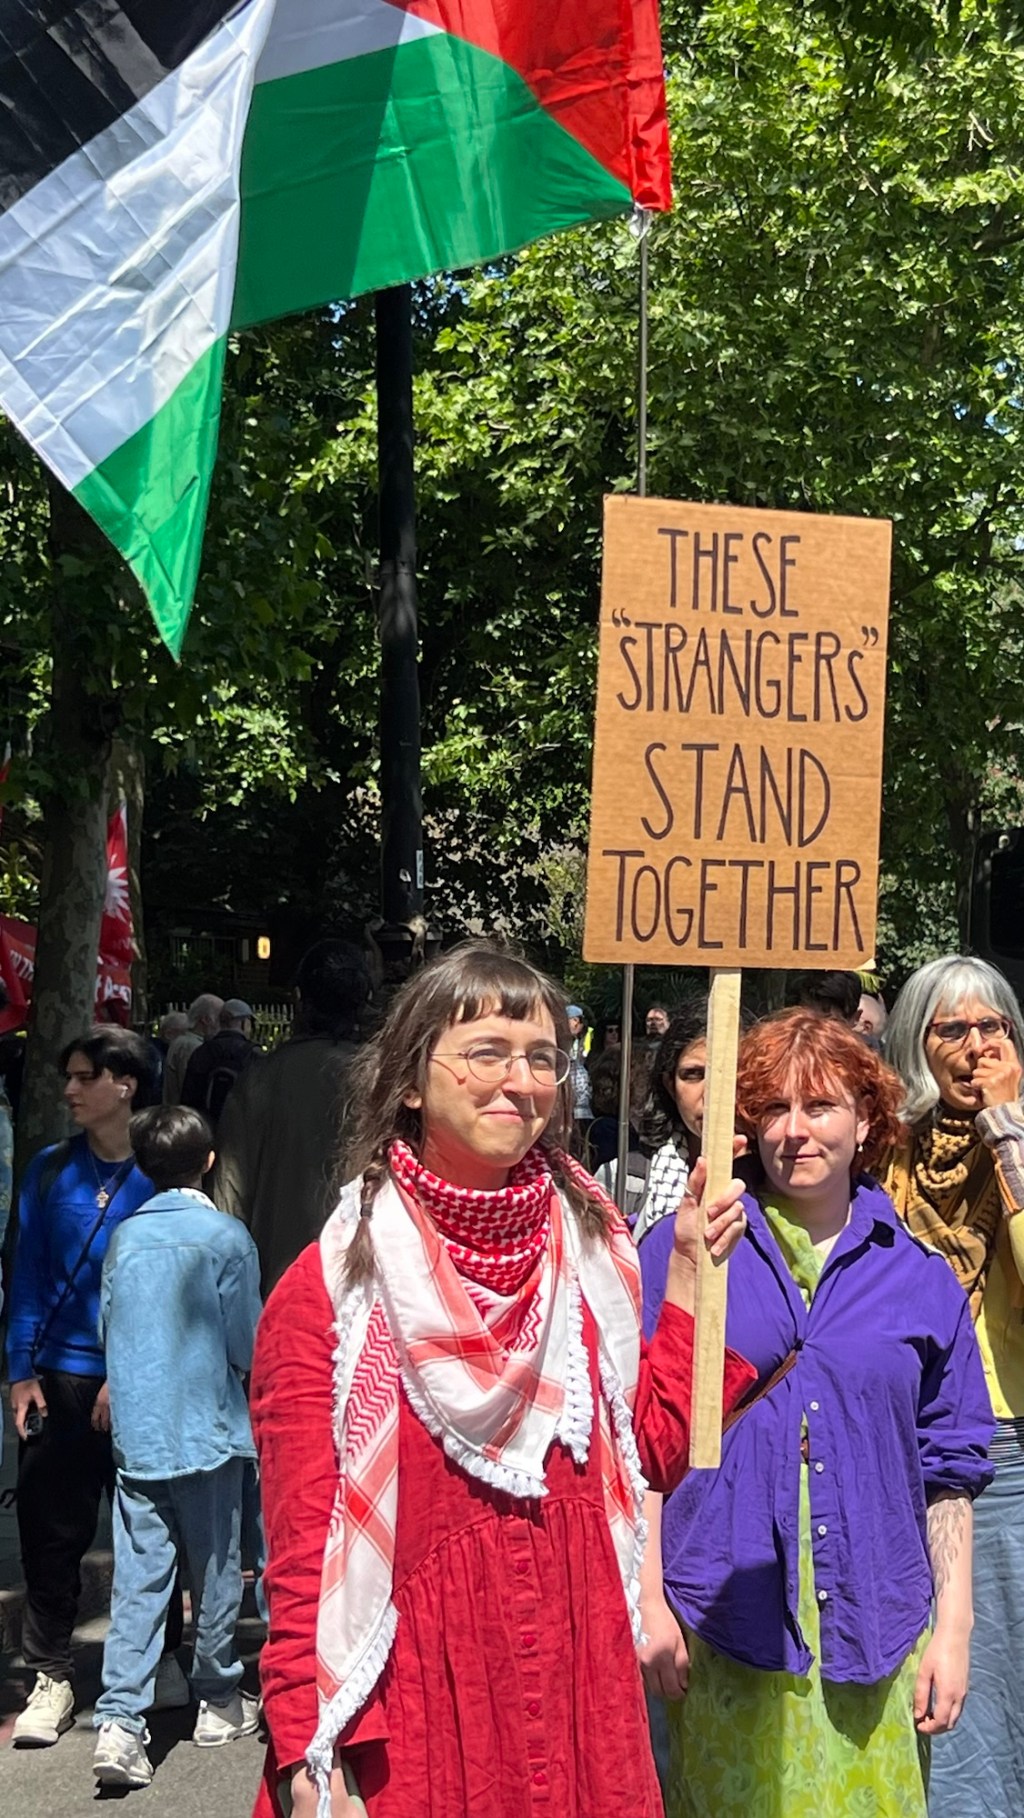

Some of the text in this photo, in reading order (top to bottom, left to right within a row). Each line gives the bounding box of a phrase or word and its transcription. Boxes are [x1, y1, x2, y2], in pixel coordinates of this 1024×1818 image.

[658, 528, 801, 618] THESE
[611, 608, 879, 723] “STRANGERS”
[641, 742, 831, 848] STAND
[602, 850, 864, 952] TOGETHER
